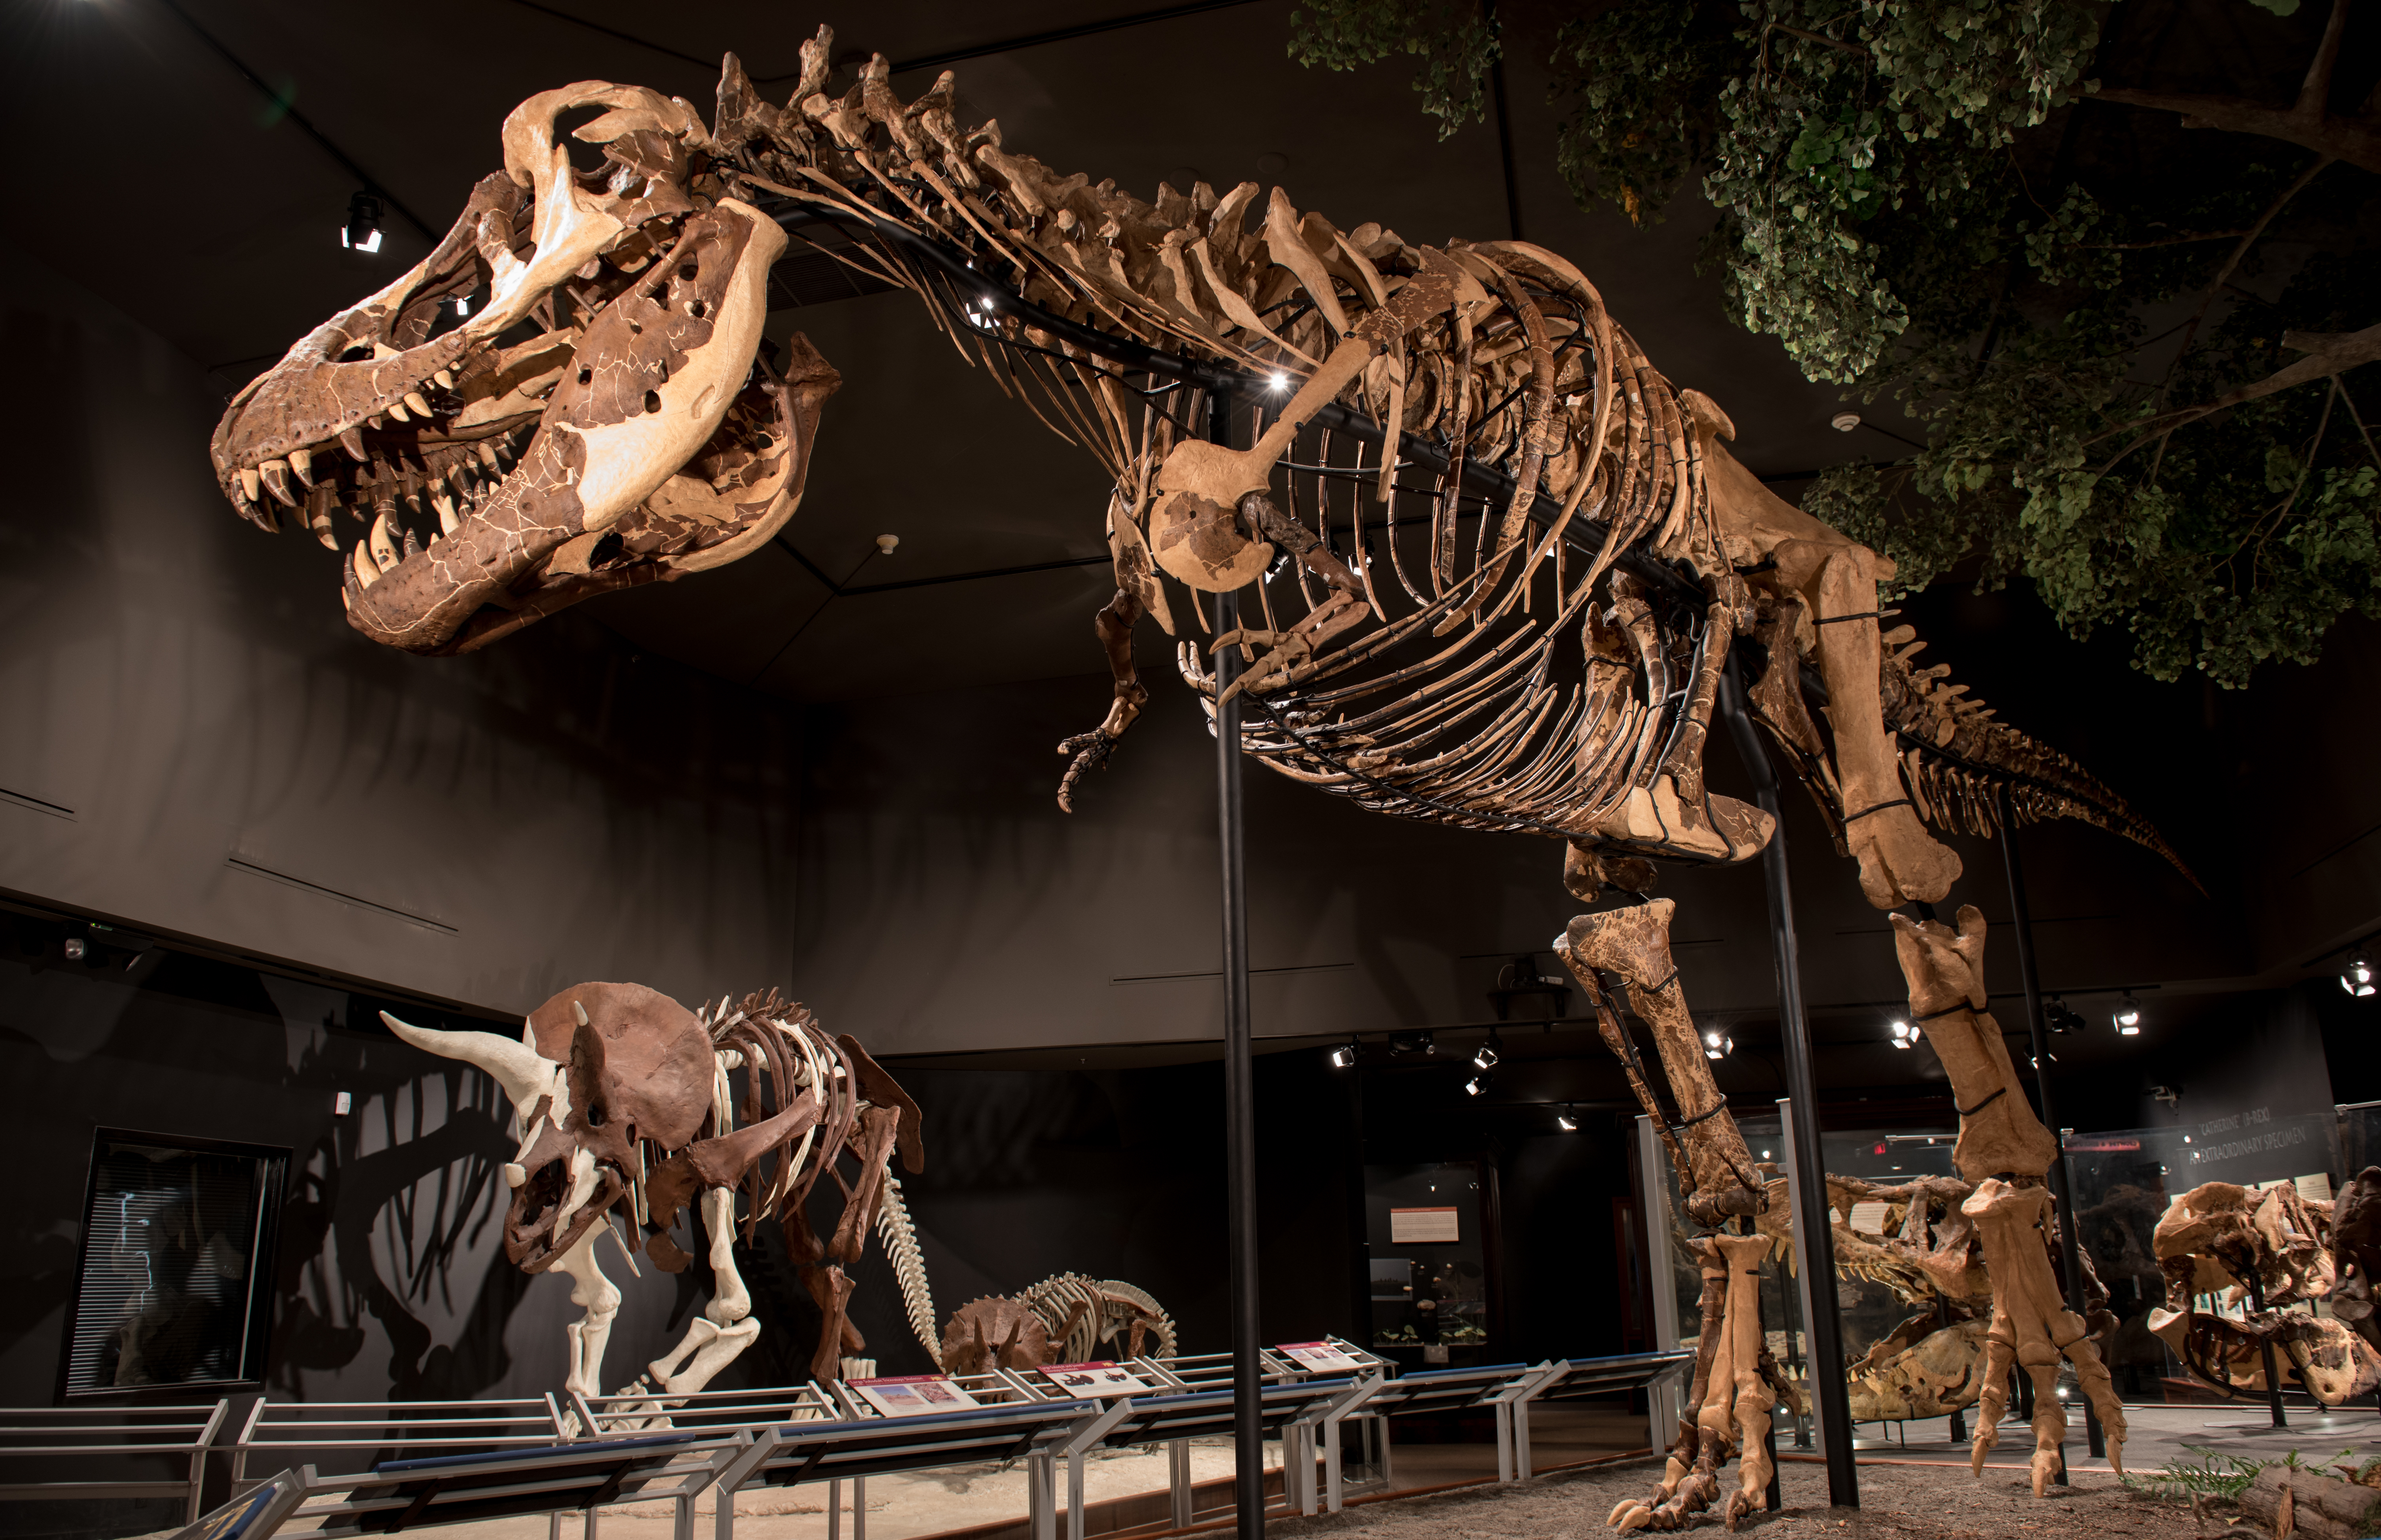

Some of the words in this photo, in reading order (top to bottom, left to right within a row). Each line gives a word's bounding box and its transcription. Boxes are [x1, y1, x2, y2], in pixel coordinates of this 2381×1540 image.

[2242, 1106, 2271, 1127] (B-REX)
[2189, 1150, 2201, 1165] AN
[2201, 1135, 2263, 1163] EXTRAORDINARY
[2263, 1126, 2307, 1150] SPECIMEN
